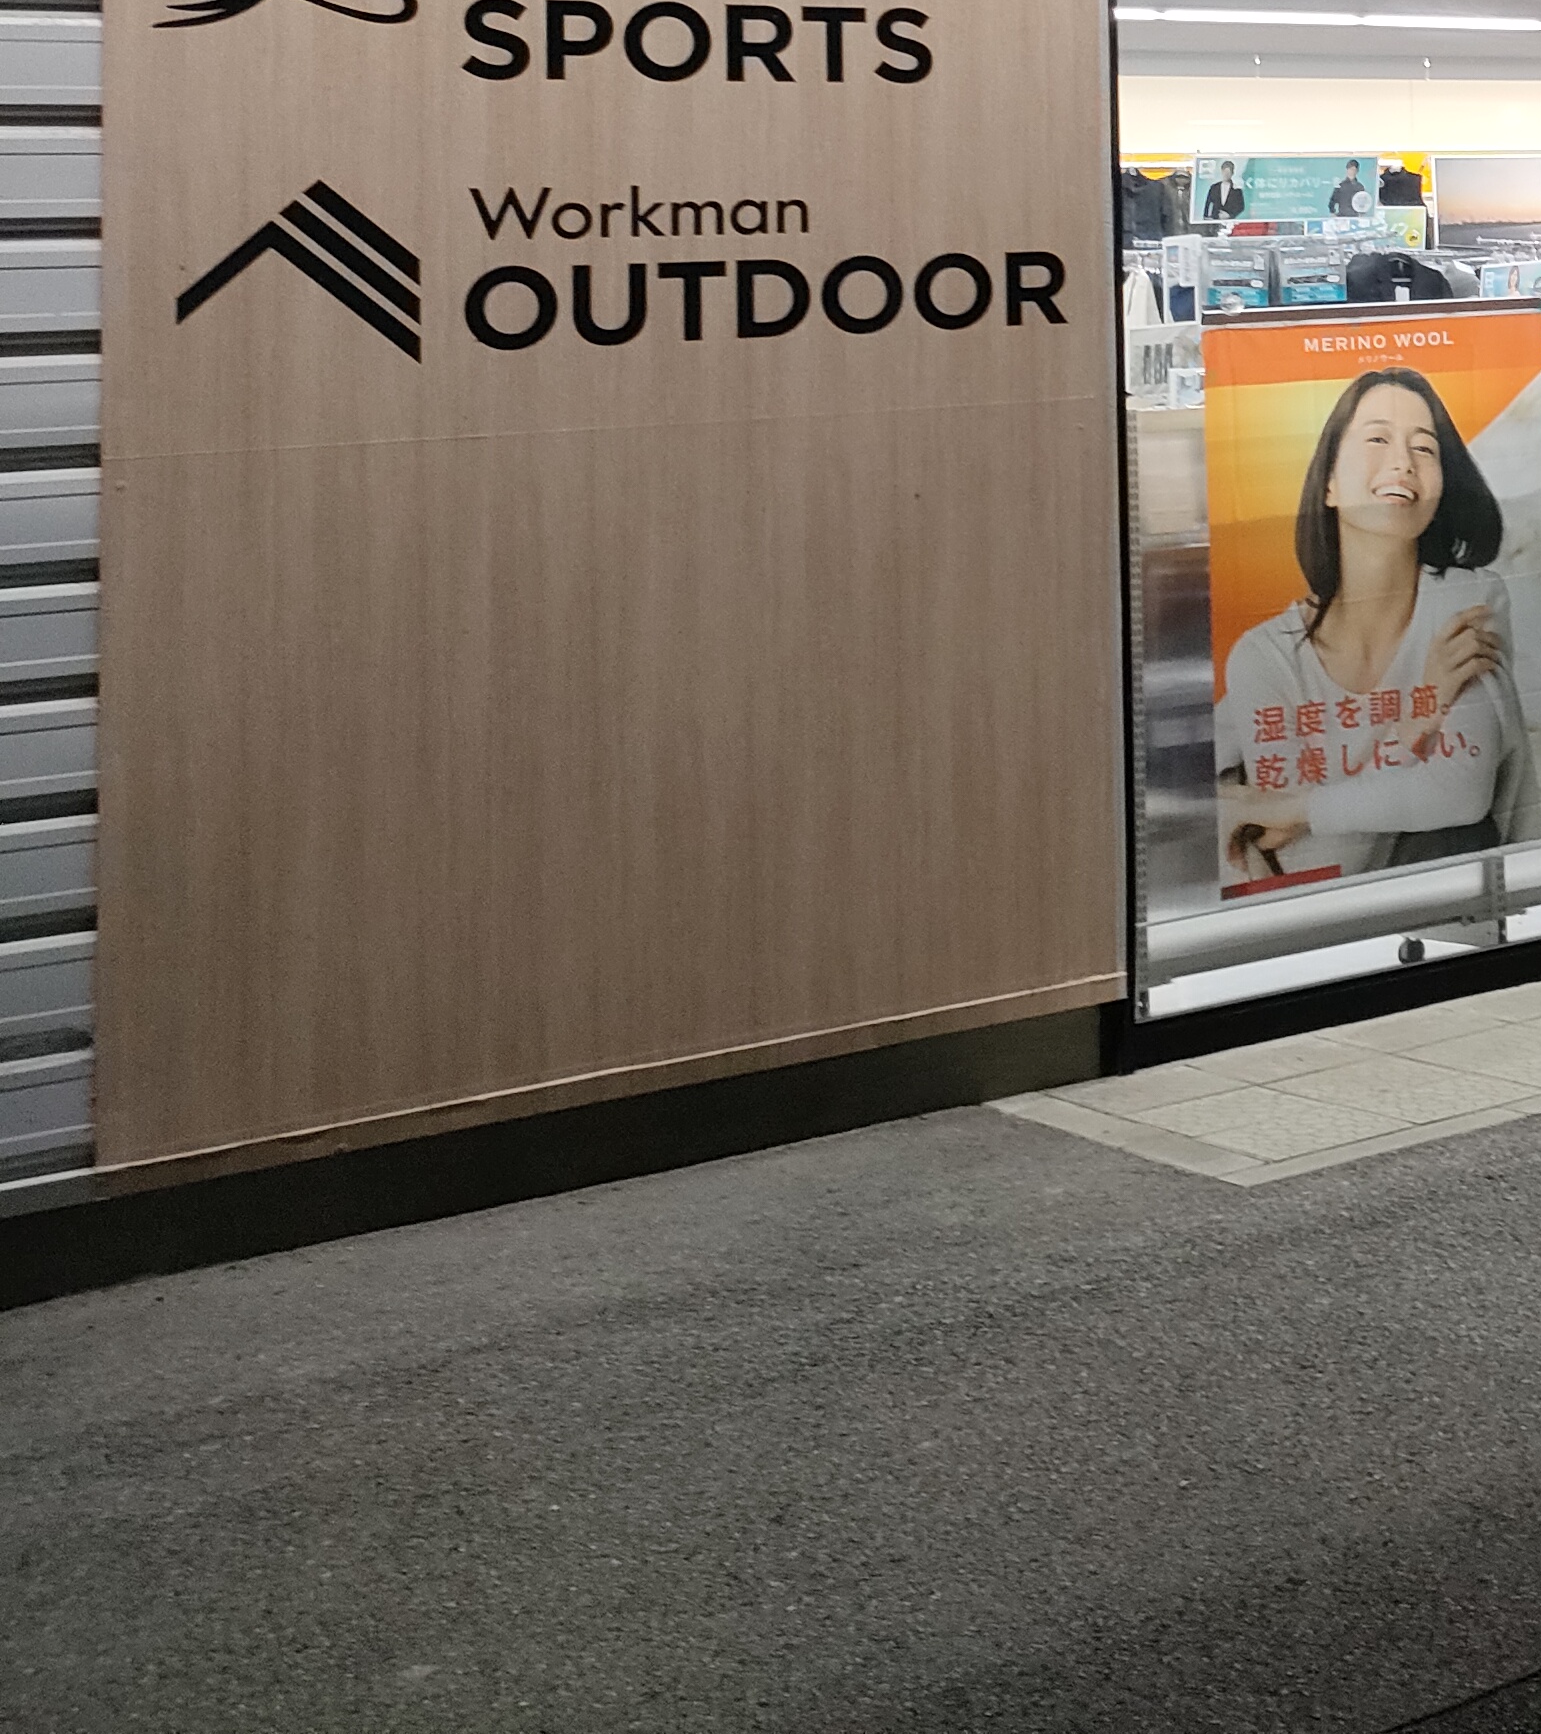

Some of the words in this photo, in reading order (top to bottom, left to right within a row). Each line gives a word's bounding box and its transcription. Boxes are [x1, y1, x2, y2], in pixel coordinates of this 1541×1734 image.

[468, 185, 810, 239] Workman
[463, 250, 1068, 352] OUTDOOR
[1303, 334, 1387, 353] MERINO
[1393, 331, 1455, 348] WOOL
[1253, 684, 1450, 744] 湿度を調節。
[1255, 731, 1481, 792] 乾燥しにくい。
